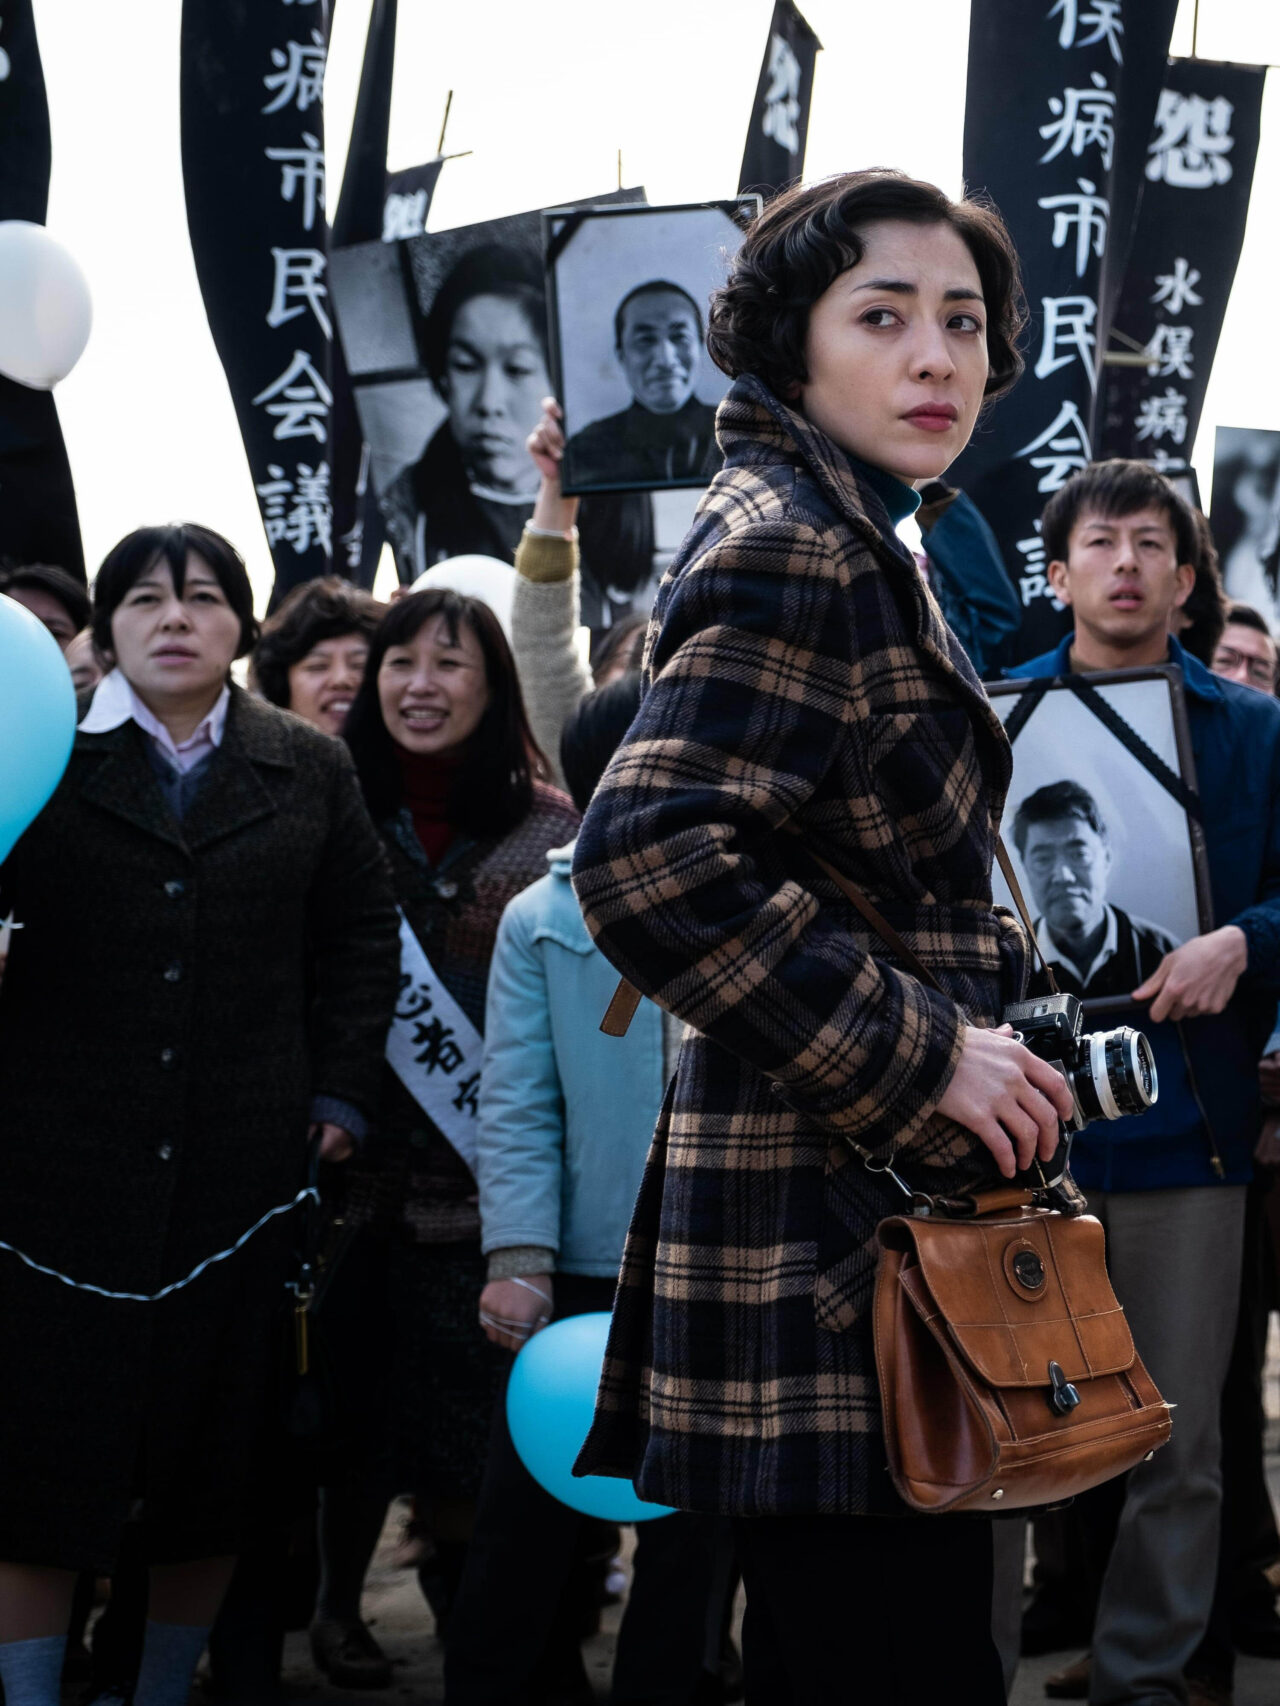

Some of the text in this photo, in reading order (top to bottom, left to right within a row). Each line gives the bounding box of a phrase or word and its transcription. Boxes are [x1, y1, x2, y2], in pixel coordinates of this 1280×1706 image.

[252, 0, 334, 560] 病市民会議
